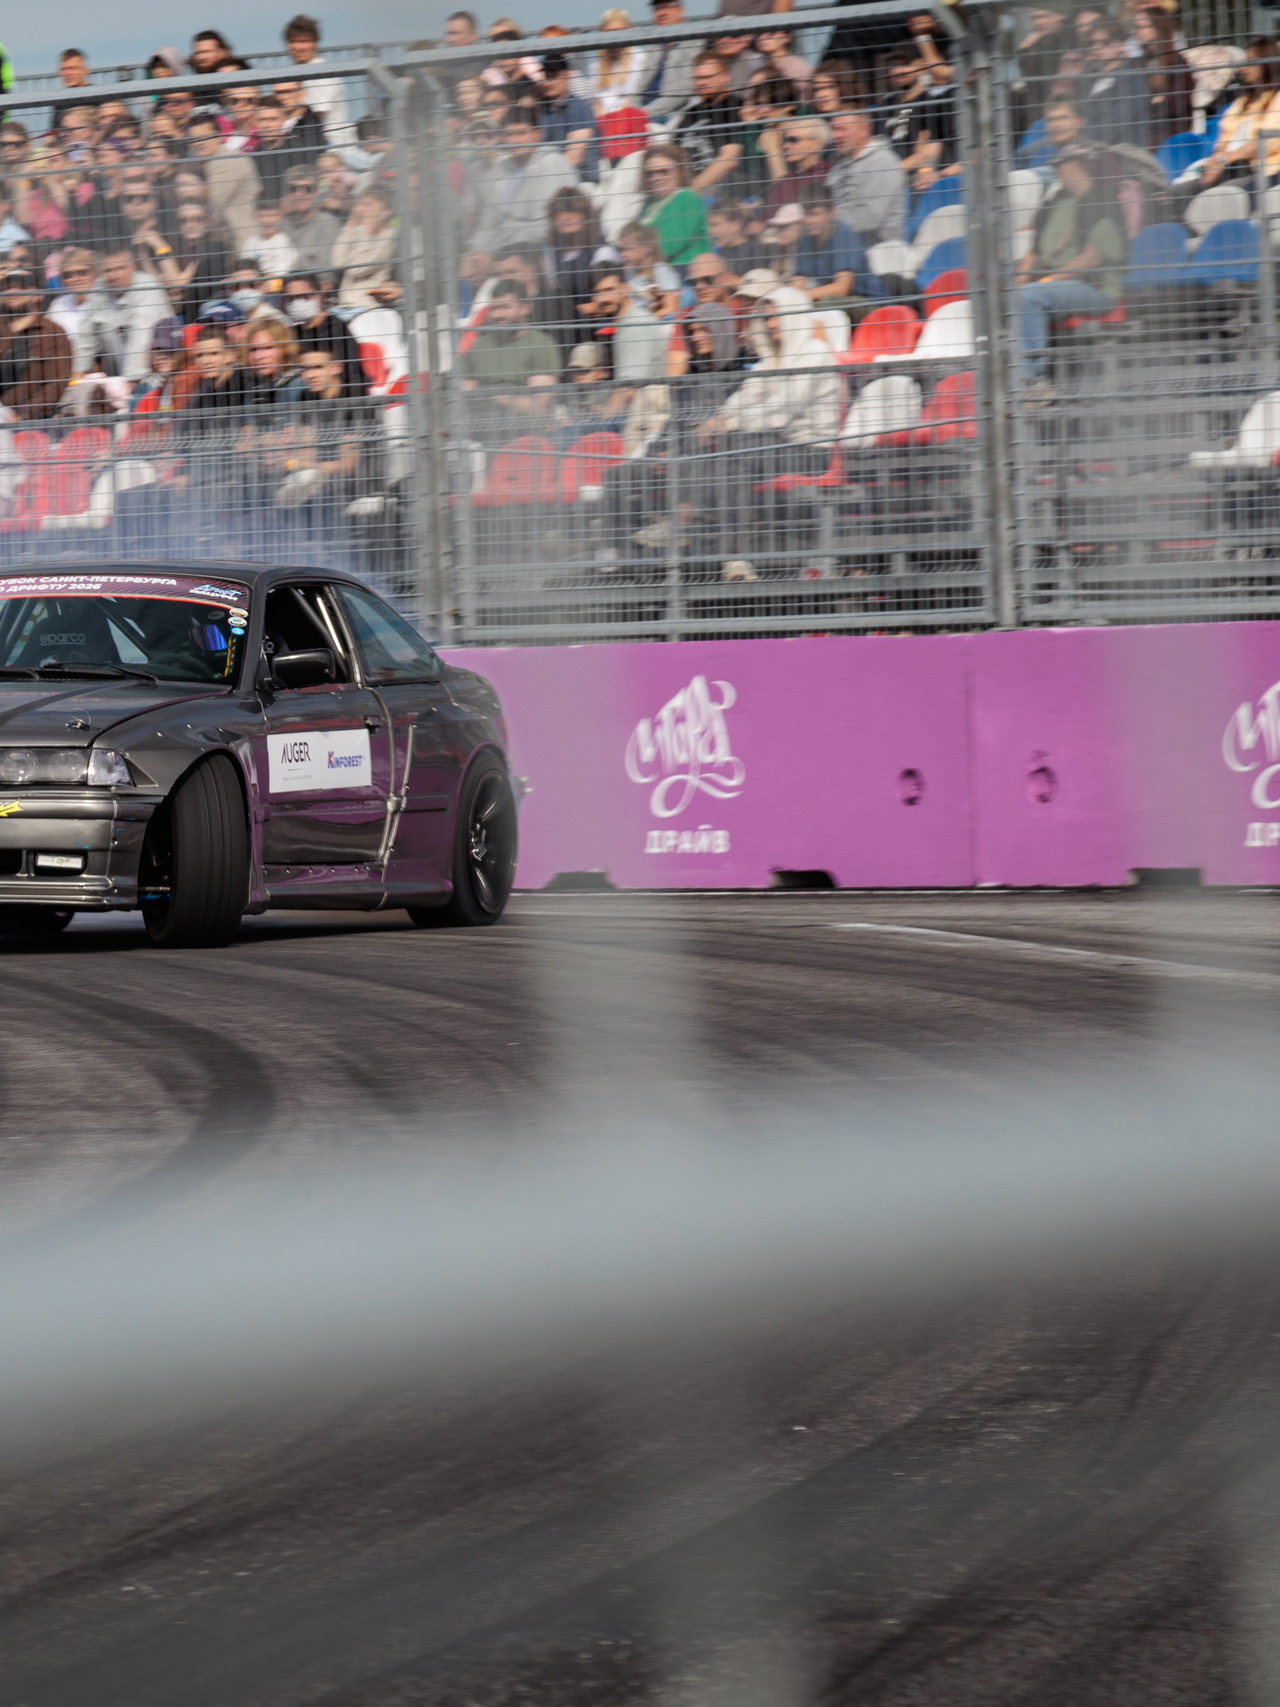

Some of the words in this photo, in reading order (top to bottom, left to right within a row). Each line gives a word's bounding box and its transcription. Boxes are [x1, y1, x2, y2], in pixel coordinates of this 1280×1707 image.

[39, 576, 177, 585] САНКТ-ПЕТЕРБУРГА
[6, 583, 67, 593] ДРИФТУ
[40, 633, 85, 646] sparco
[281, 742, 311, 763] AUGER
[644, 824, 731, 853] ДРАЙВ
